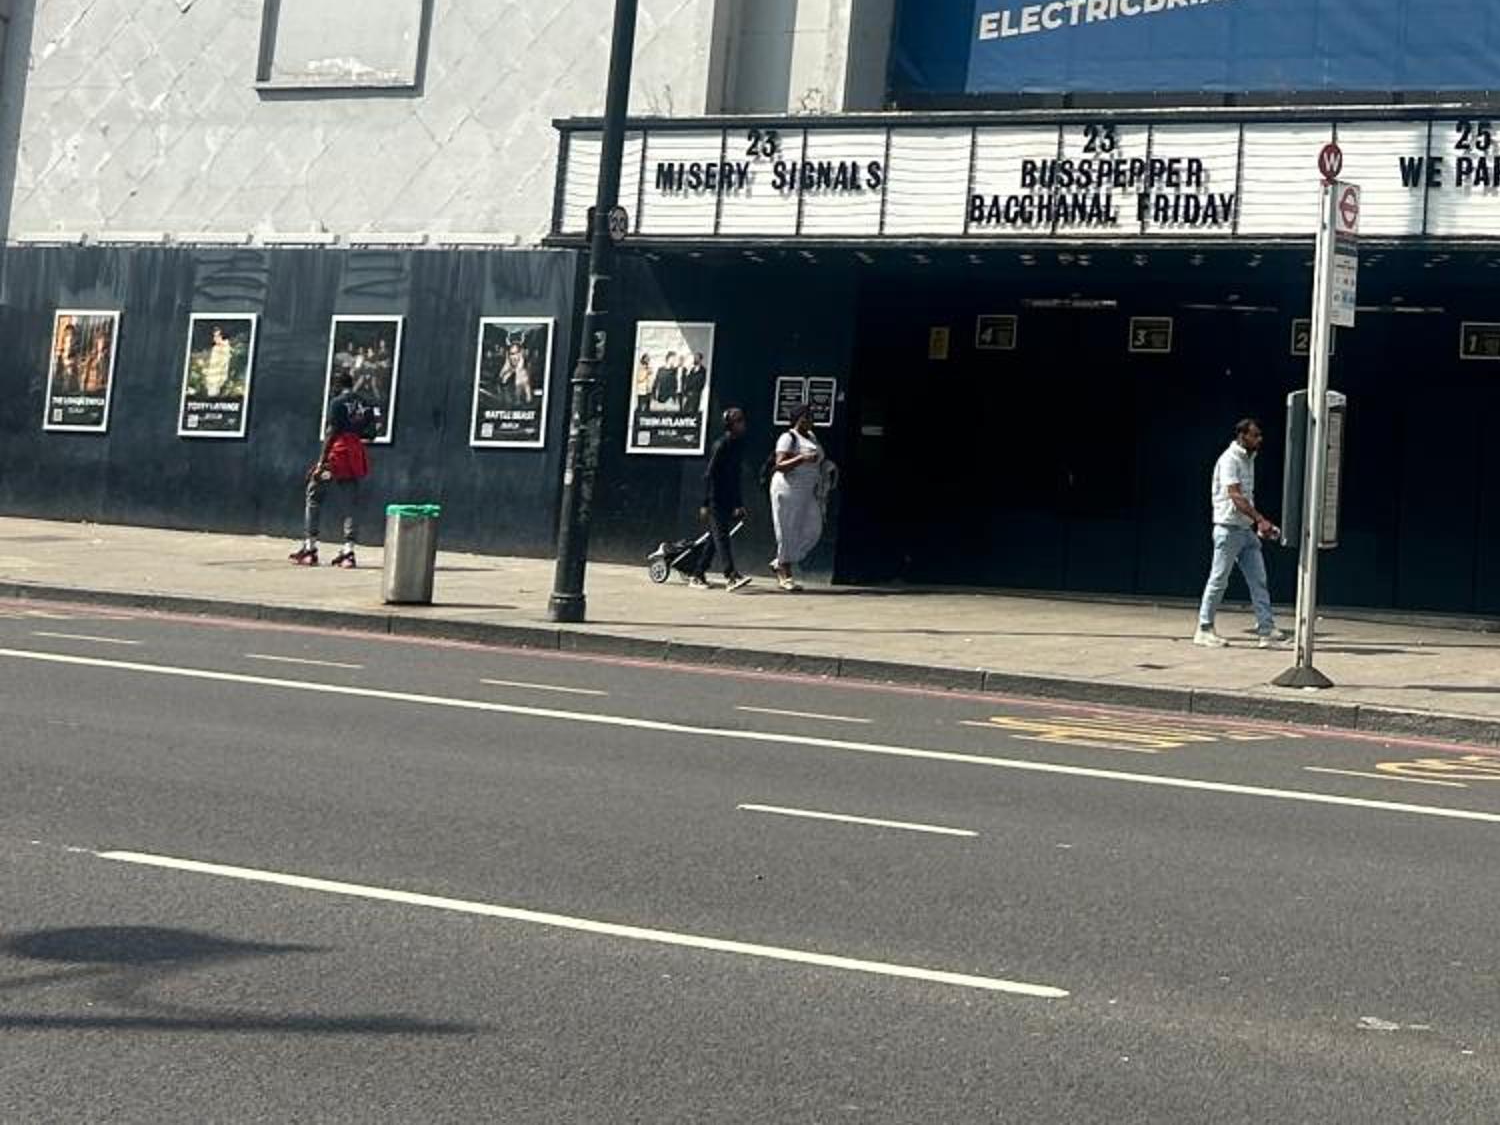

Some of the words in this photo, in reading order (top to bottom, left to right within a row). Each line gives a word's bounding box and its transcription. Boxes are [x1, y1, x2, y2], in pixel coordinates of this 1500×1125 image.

[746, 130, 777, 157] 23
[1083, 125, 1116, 153] 23
[1455, 118, 1492, 151] 25
[655, 162, 750, 191] MISERY
[771, 161, 883, 190] SIGNALS
[1021, 158, 1204, 188] BUSSPEPPER
[1322, 153, 1341, 172] W
[1399, 156, 1443, 187] WE
[970, 195, 1118, 223] BACCHANAL
[1138, 193, 1236, 223] FRIDAY
[1134, 328, 1146, 346] 3
[1296, 331, 1309, 348] 2
[1469, 334, 1479, 352] 1
